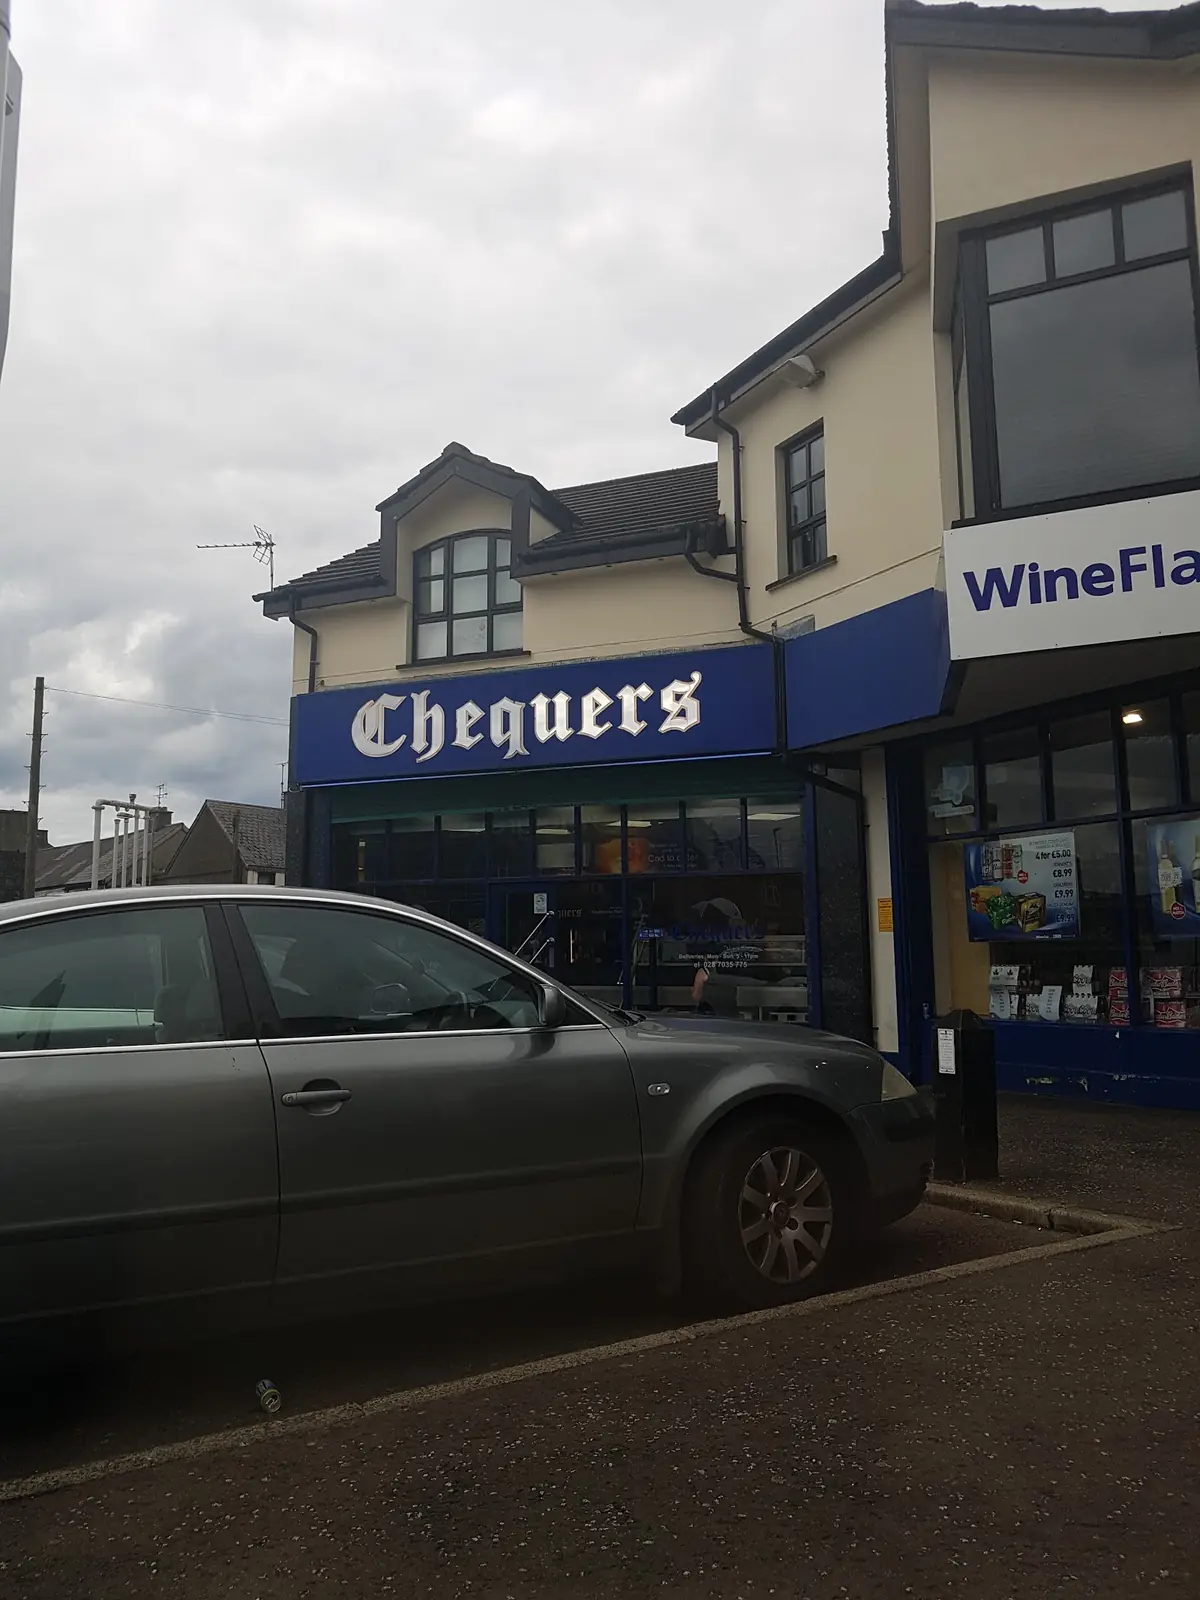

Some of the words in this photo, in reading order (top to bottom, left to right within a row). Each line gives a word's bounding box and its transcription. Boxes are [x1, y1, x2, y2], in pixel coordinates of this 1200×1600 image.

[351, 670, 703, 764] Chequers
[1041, 851, 1050, 860] for
[1052, 849, 1071, 859] £5.00
[1053, 868, 1072, 878] £8.99
[1054, 889, 1074, 899] £9.99
